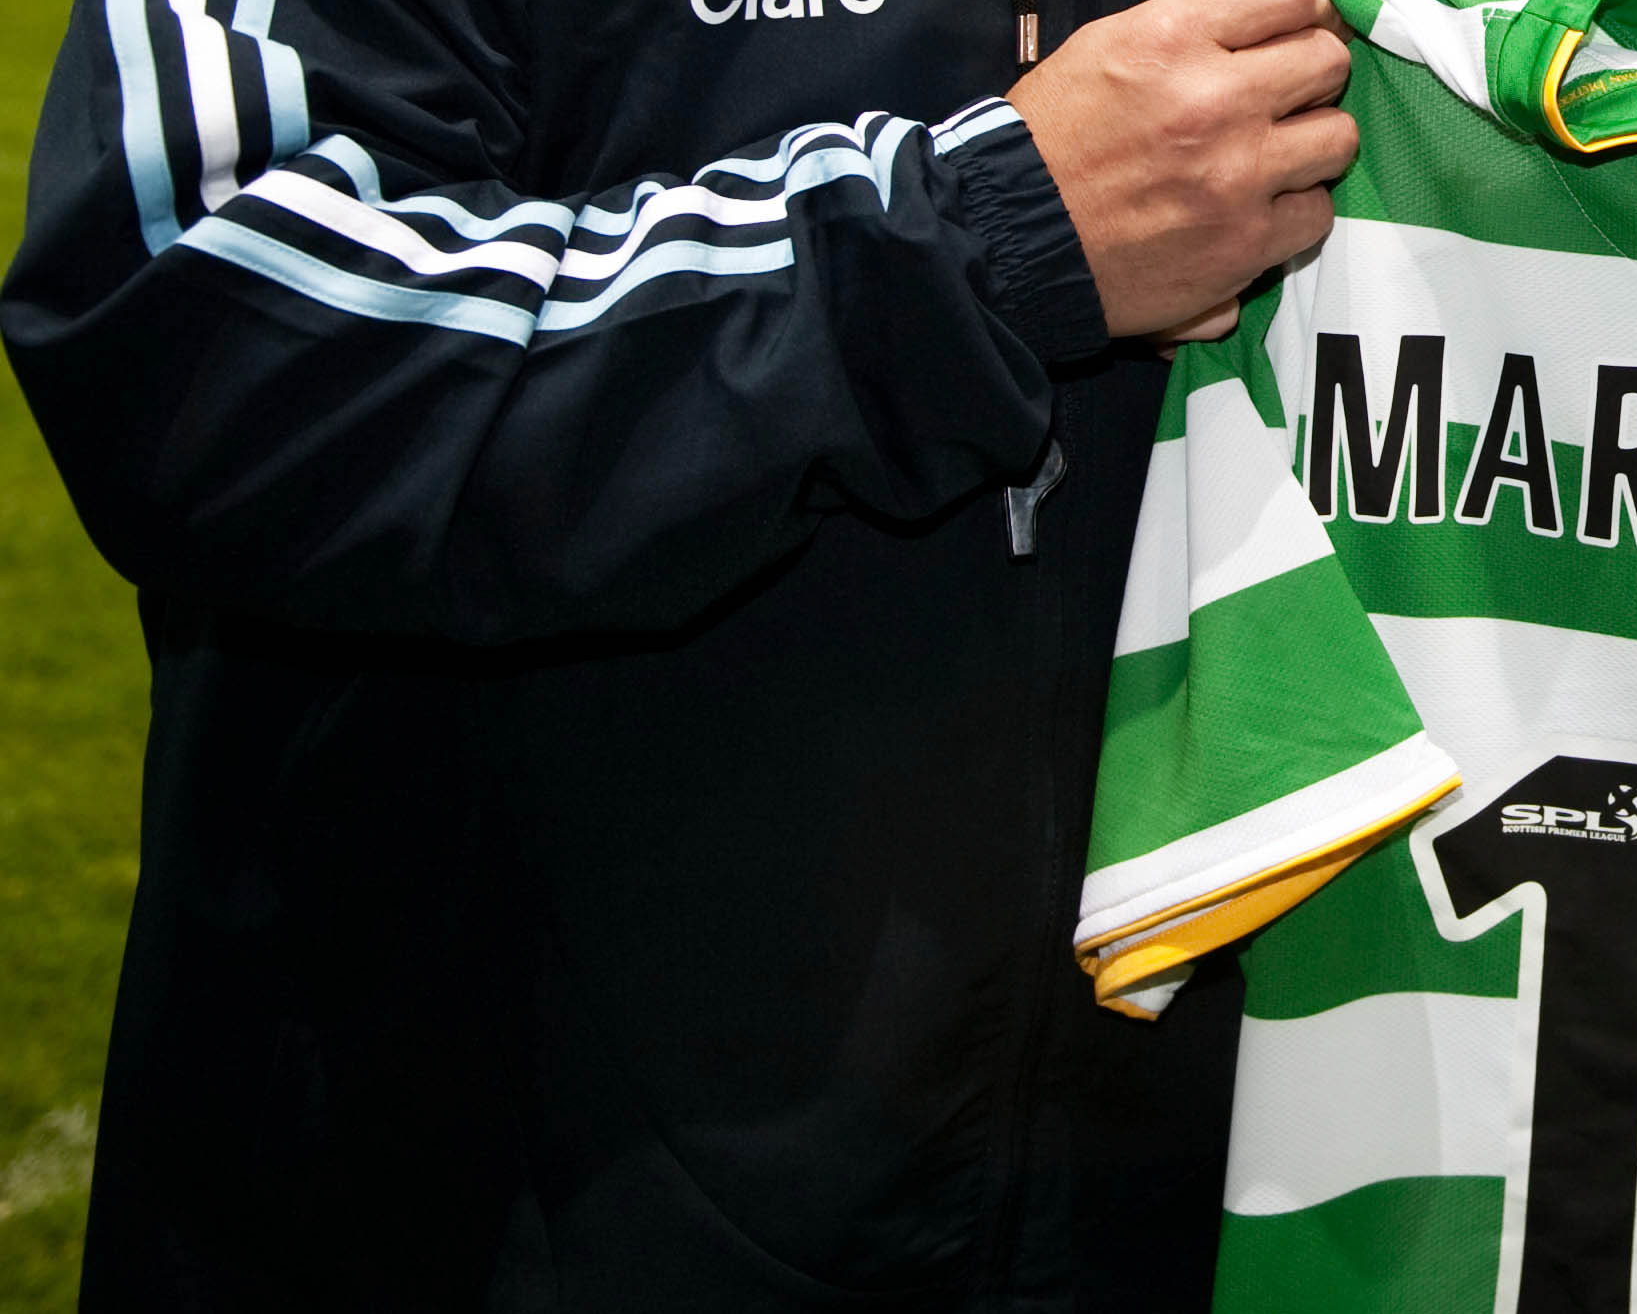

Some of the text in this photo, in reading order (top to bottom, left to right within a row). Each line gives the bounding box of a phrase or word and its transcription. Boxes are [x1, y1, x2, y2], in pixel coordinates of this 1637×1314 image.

[1500, 803, 1627, 834] SPL
[1502, 824, 1627, 843] SCOTTISH PREMIER LEAGUE
